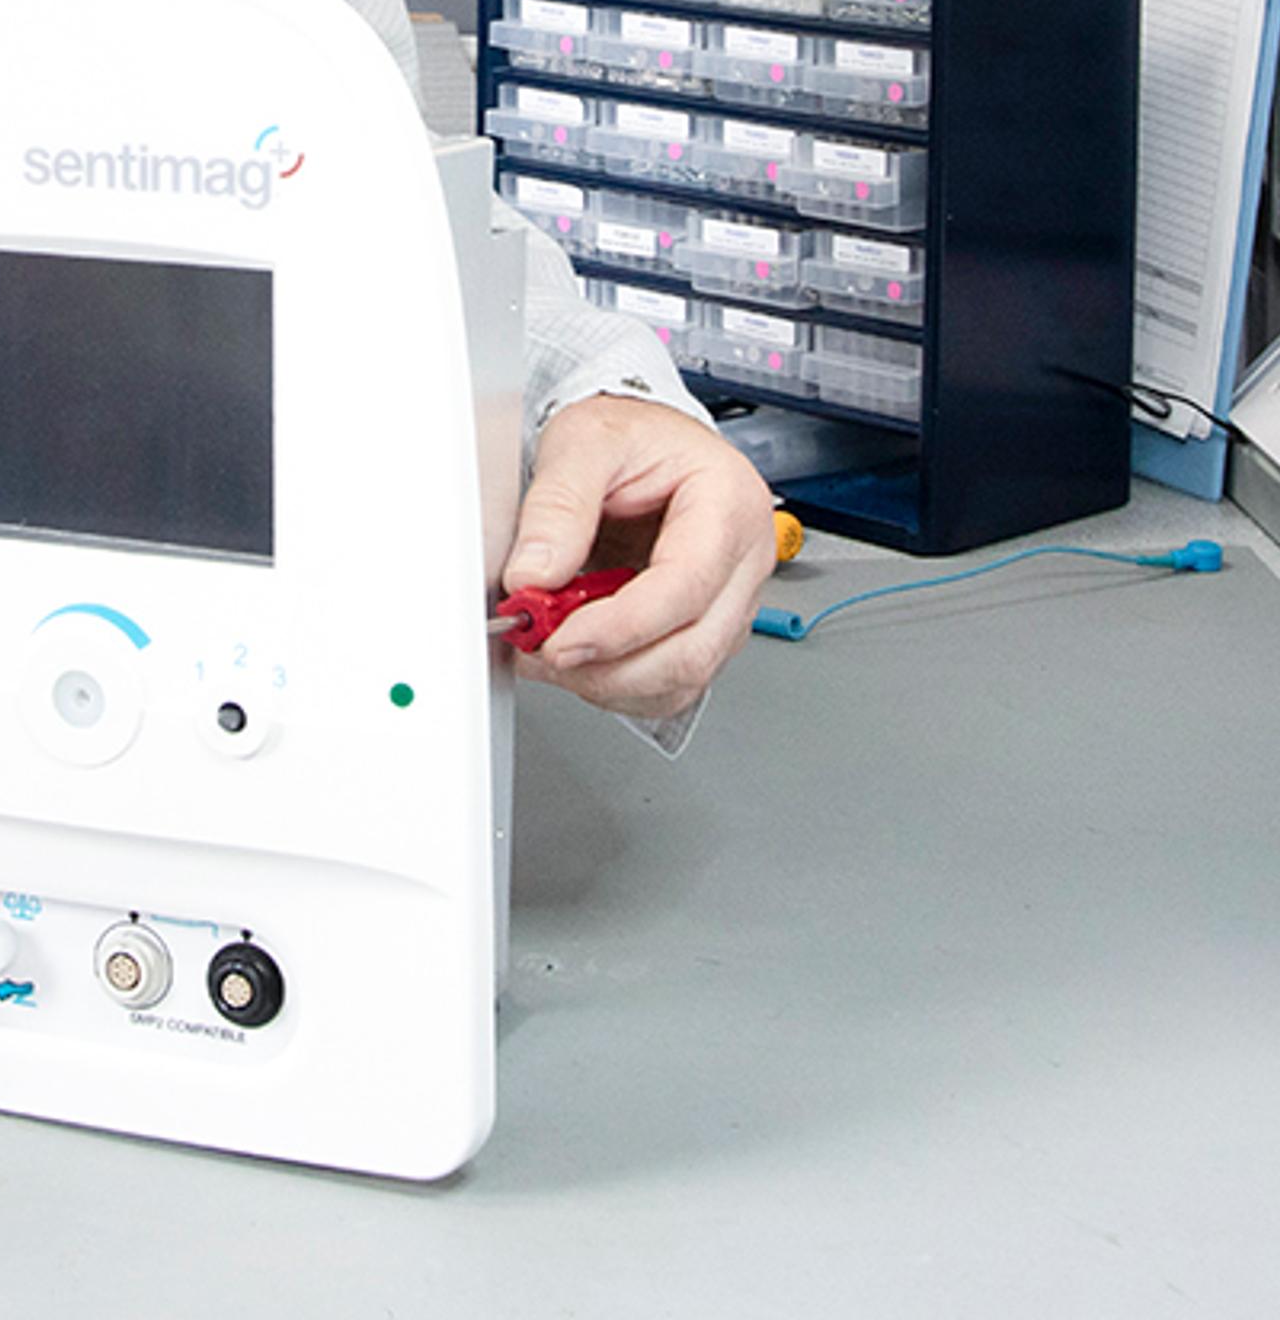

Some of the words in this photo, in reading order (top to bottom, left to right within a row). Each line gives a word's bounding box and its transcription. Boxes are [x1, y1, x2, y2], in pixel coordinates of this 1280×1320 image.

[23, 143, 272, 211] sentimag
[233, 642, 248, 668] 2
[272, 664, 287, 689] 3
[166, 1017, 246, 1044] COMPATIBLE
